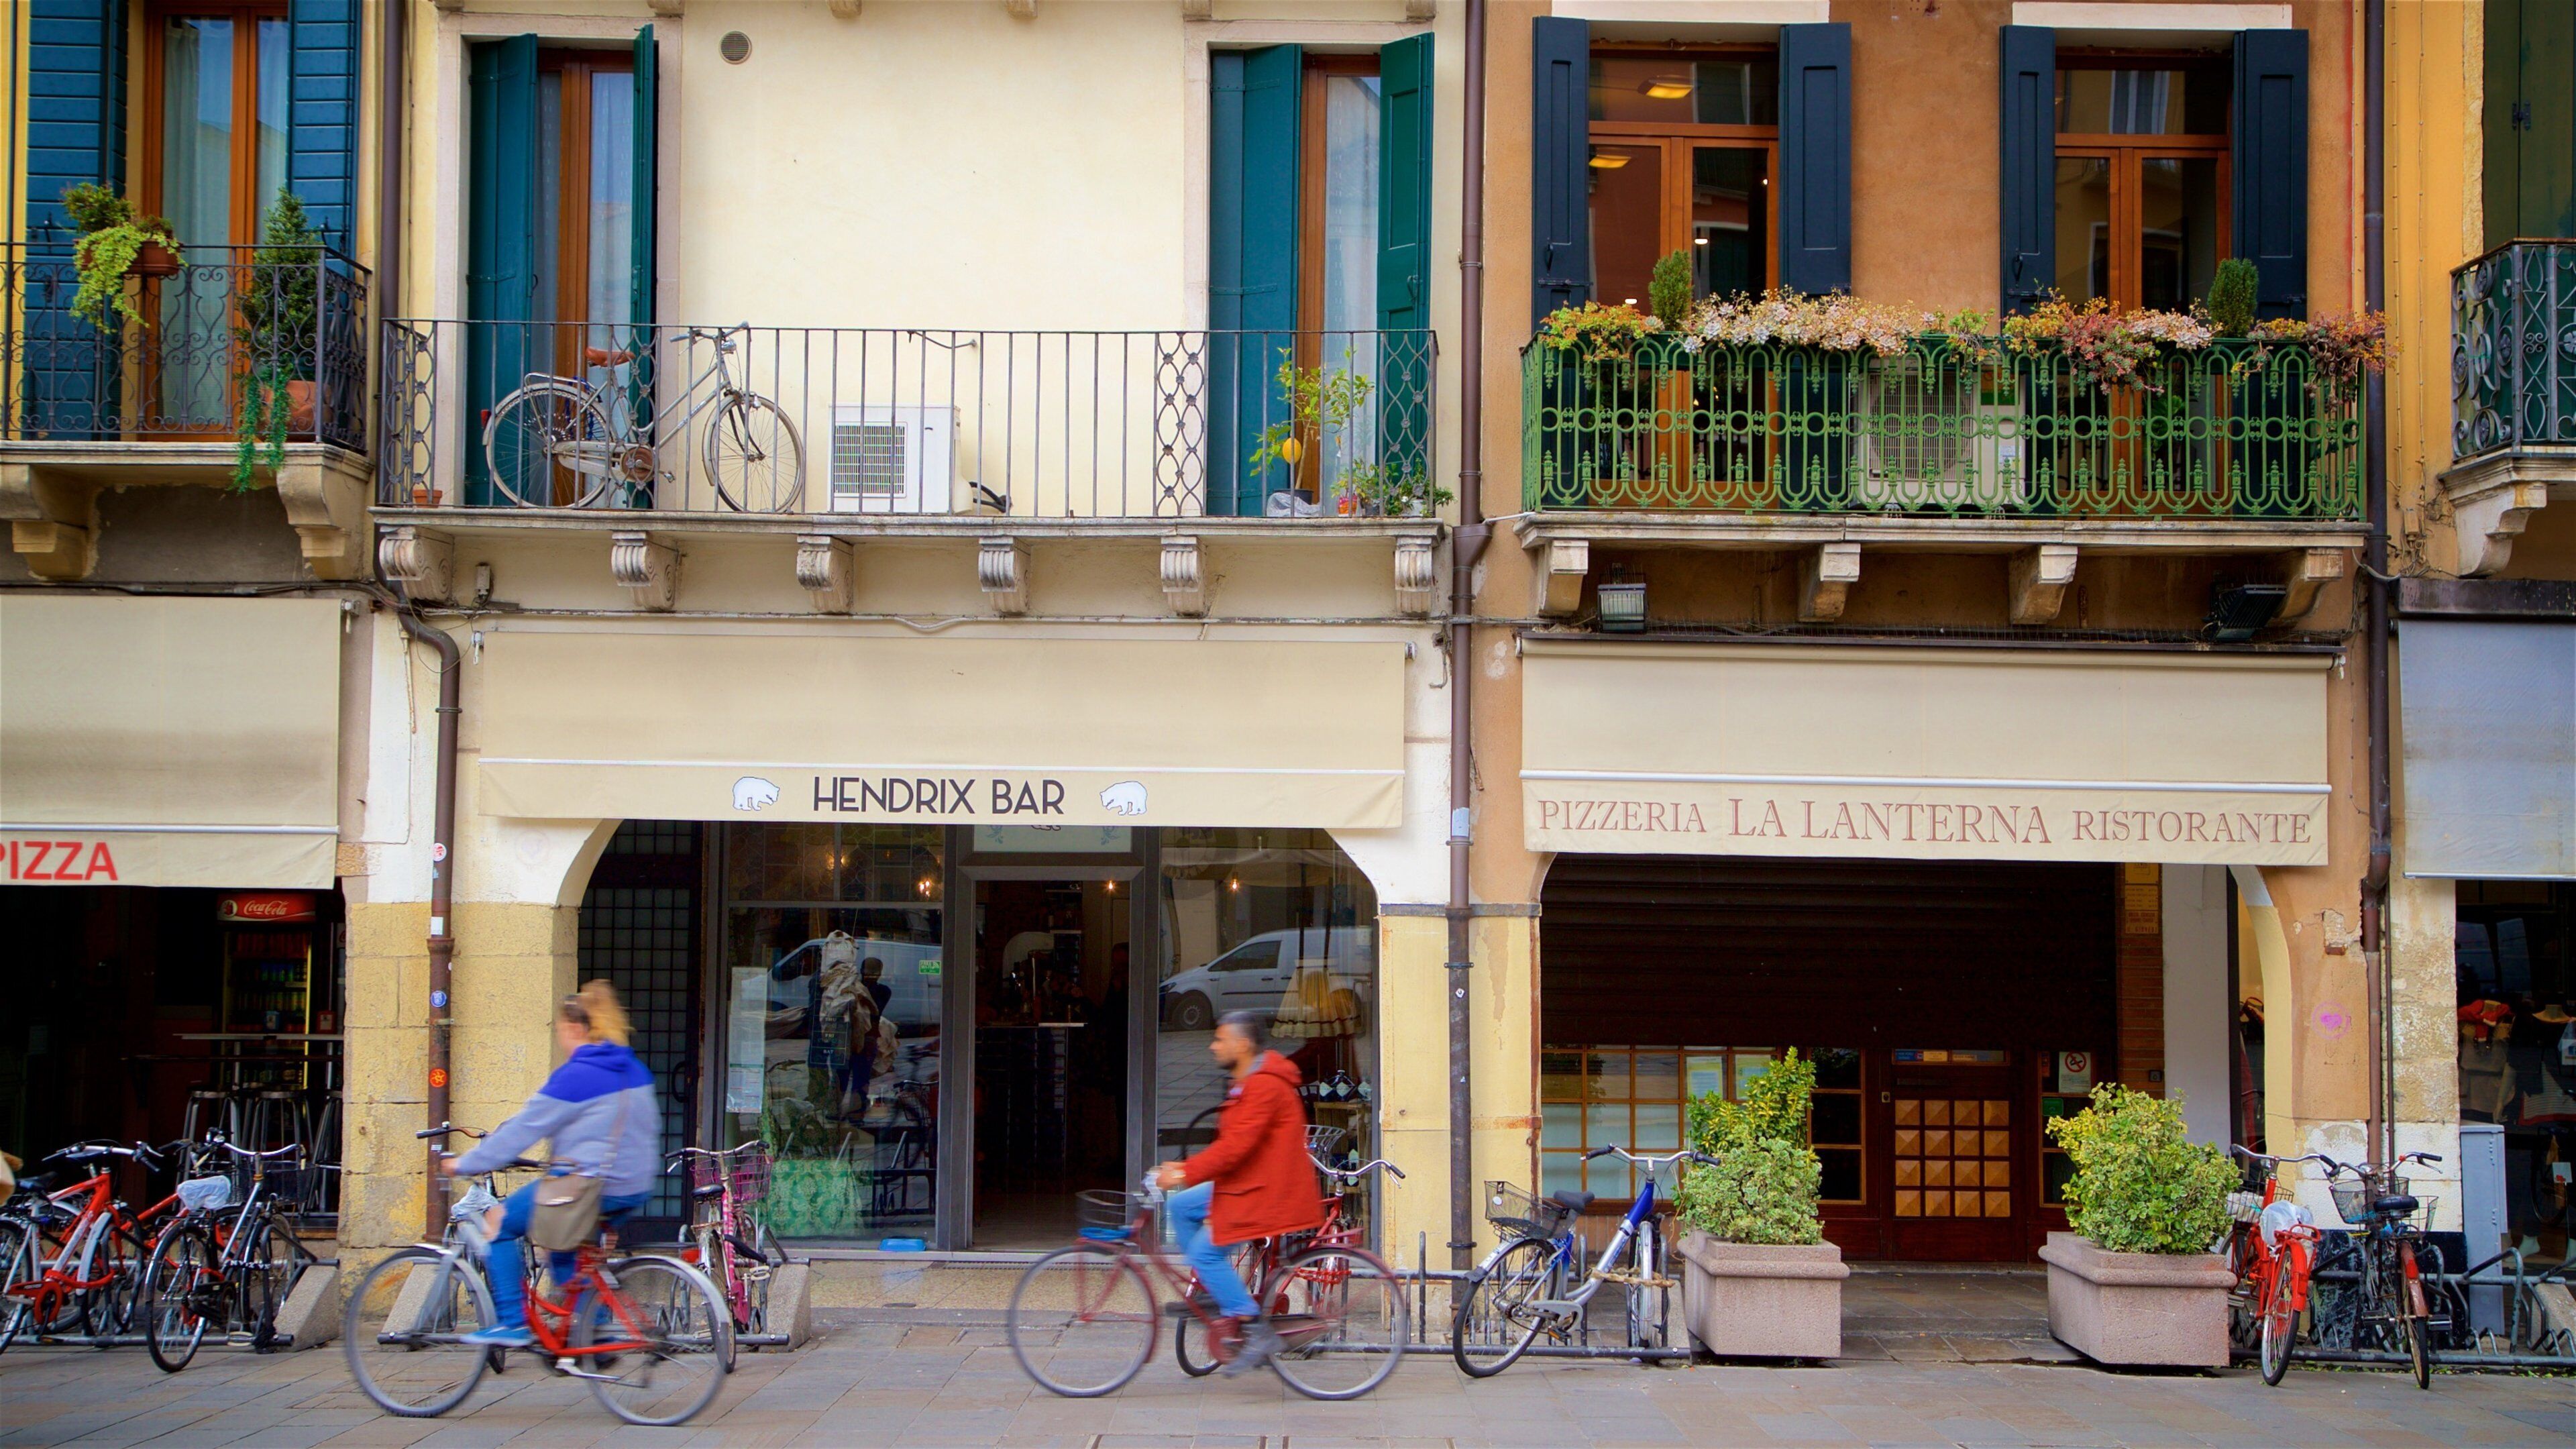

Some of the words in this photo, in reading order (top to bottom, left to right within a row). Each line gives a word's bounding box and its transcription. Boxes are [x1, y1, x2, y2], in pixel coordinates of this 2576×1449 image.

[813, 776, 976, 814] HENDRIX
[991, 779, 1065, 814] BAR
[1538, 800, 1707, 833] PIZZERIA
[1727, 798, 1787, 837] LA
[1801, 800, 2053, 844] LANTERNA
[2072, 810, 2311, 843] RISTORANTE
[0, 840, 119, 881] IZZA
